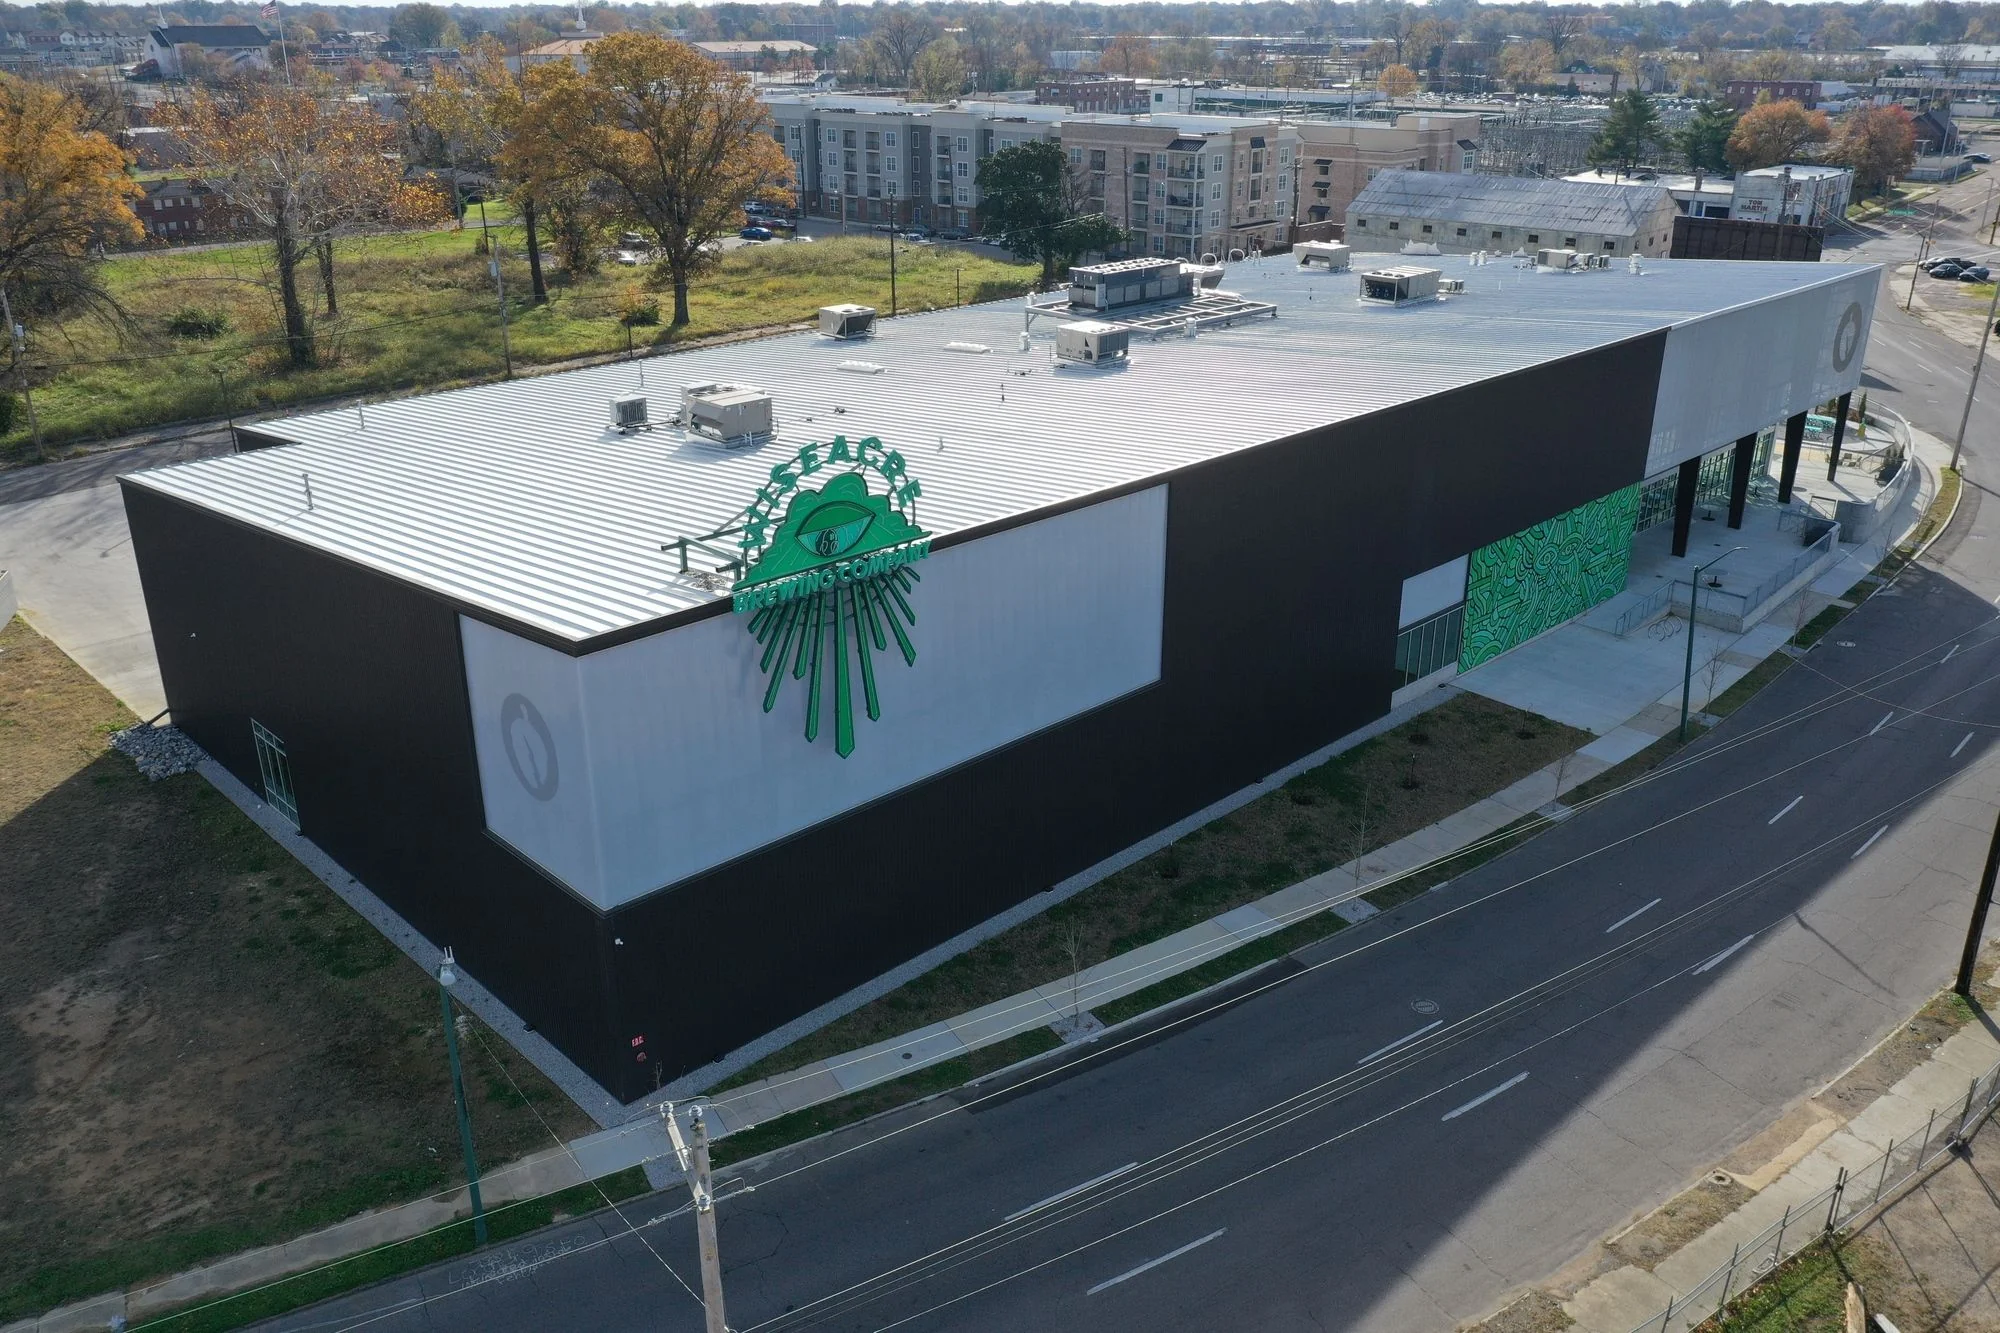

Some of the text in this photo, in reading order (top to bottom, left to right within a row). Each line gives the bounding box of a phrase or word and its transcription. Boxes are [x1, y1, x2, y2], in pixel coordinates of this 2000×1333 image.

[1741, 204, 1768, 212] MARTIN
[737, 434, 922, 548] WISEACRE
[733, 540, 931, 614] BREWING COMPANY
